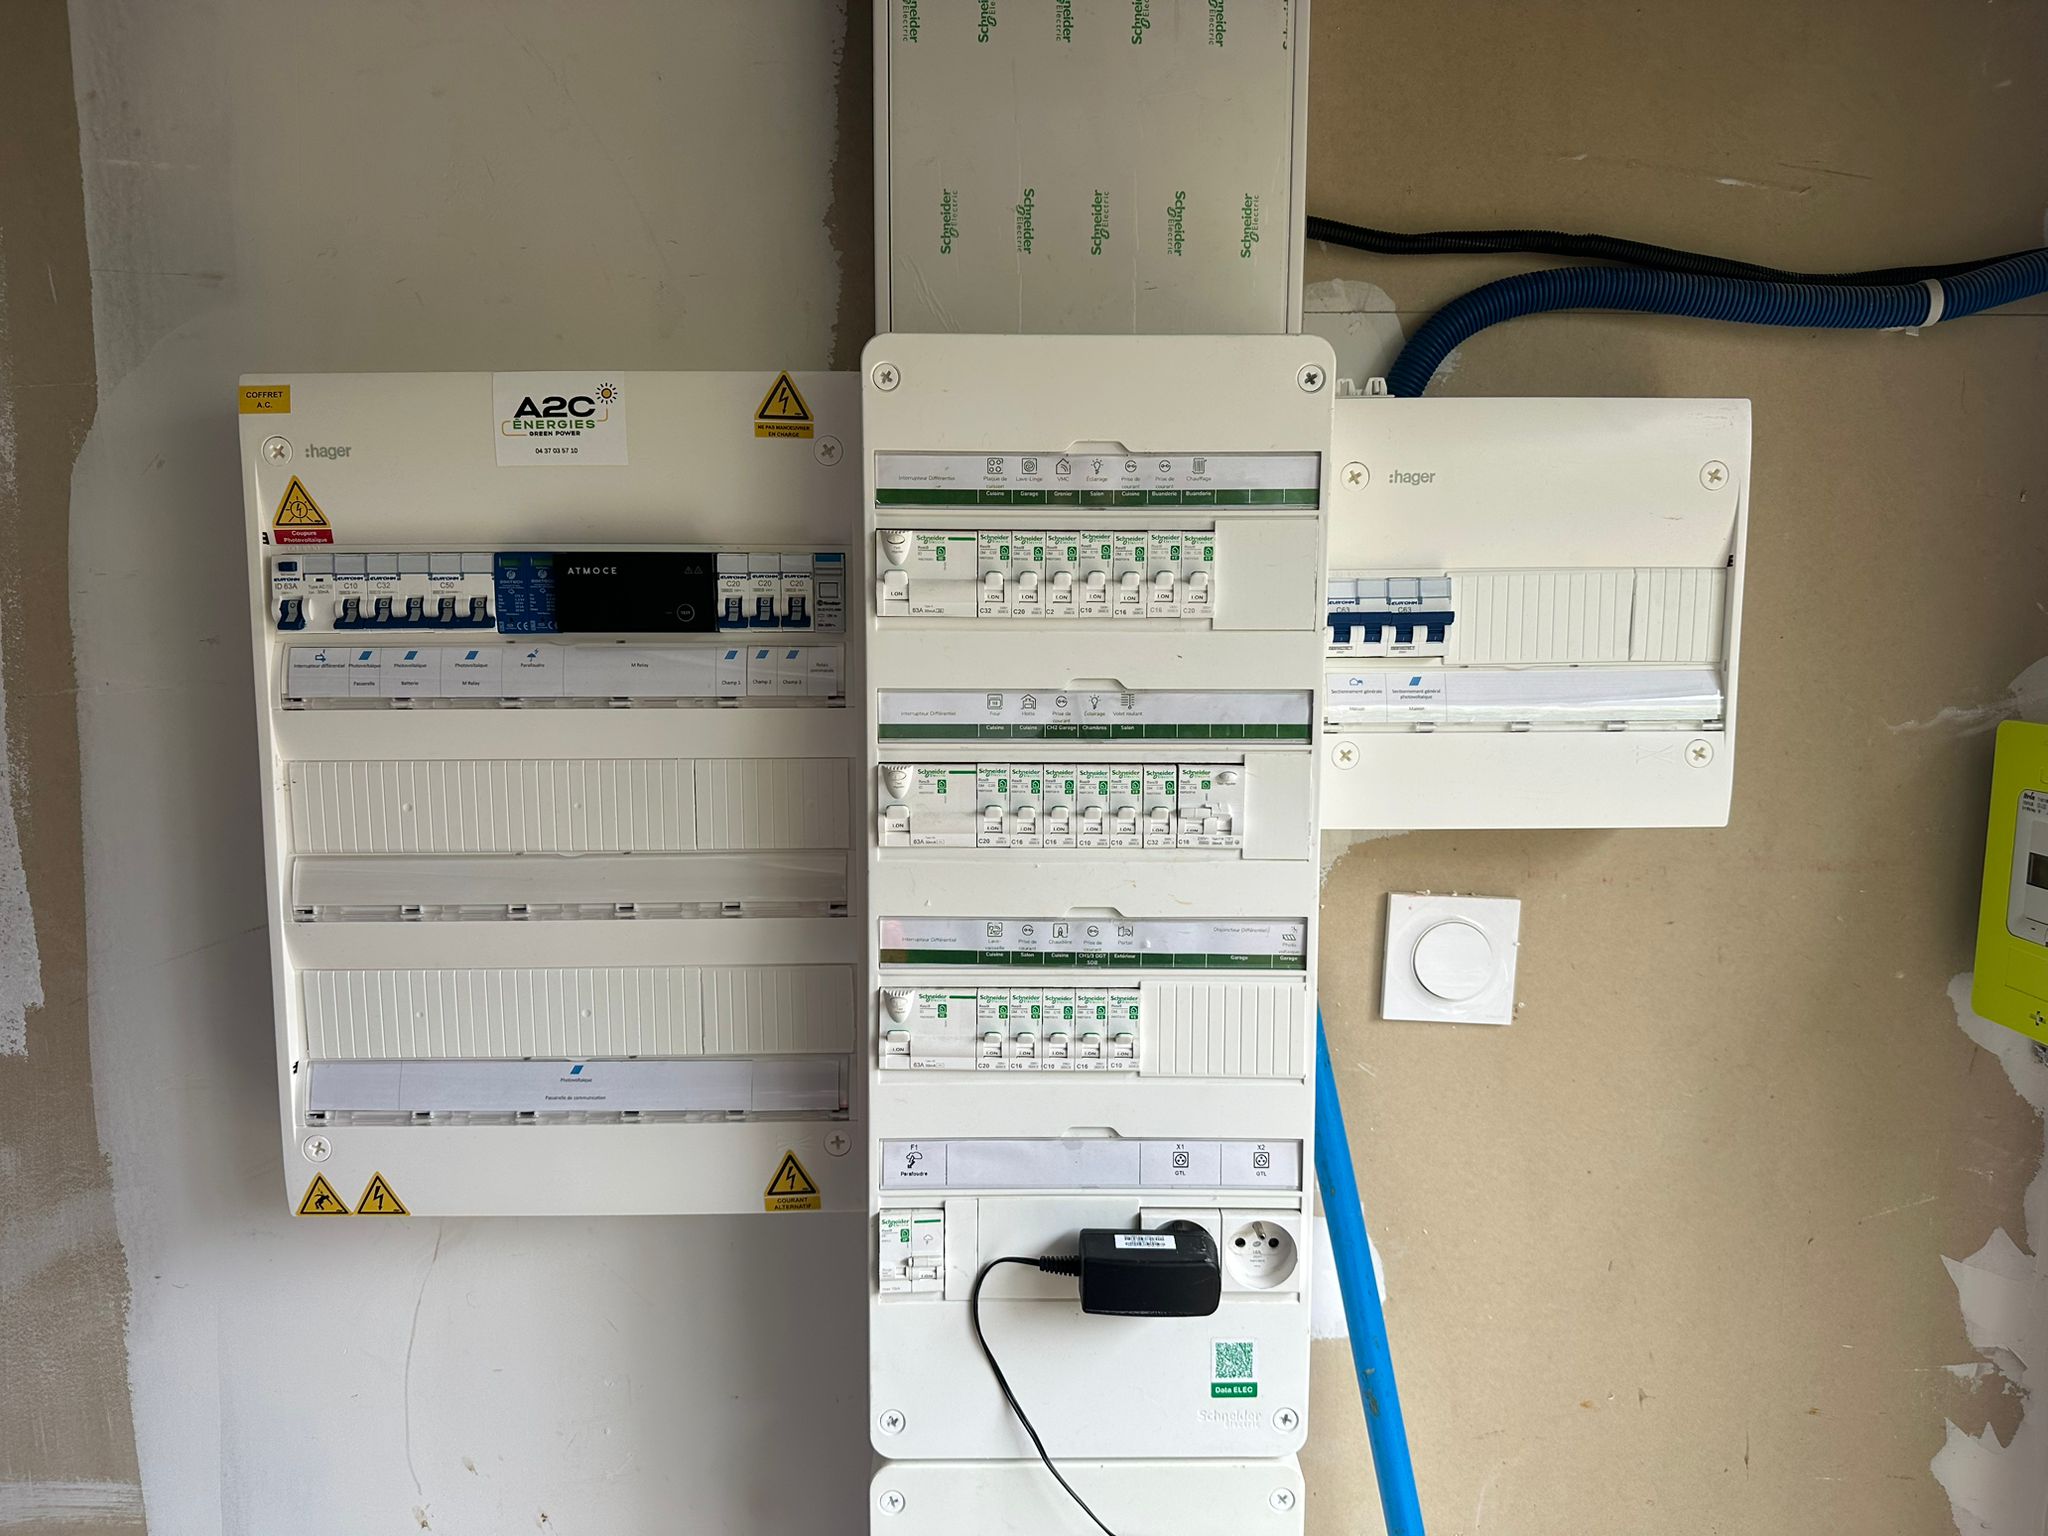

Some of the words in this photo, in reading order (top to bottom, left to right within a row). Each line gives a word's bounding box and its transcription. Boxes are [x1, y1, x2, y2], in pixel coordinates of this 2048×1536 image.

[909, 0, 921, 43] neider
[1062, 0, 1074, 43] neider
[1215, 0, 1227, 47] neider
[1102, 191, 1110, 227] Electric
[940, 188, 952, 255] Schneider
[1023, 188, 1035, 255] Schneider
[1090, 189, 1102, 256] Schneider
[1174, 190, 1186, 256] Schneider
[1240, 192, 1253, 258] Schneider
[245, 391, 284, 399] COFFRET
[256, 401, 273, 409] A.C.
[513, 395, 596, 418] A2C
[916, 535, 946, 544] Schneider
[980, 534, 1009, 543] Schneider
[1014, 535, 1043, 545] Schneider
[1048, 535, 1077, 545] Schneider
[1082, 534, 1111, 543] Schneider
[1116, 536, 1145, 545] Schneider
[1151, 534, 1180, 544] Schneider
[1184, 535, 1214, 545] Schneider
[567, 567, 618, 575] ATMOCE
[917, 769, 946, 778] Schneider
[978, 768, 1007, 777] Schneider
[1045, 770, 1074, 778] Schneider
[1111, 770, 1140, 779] Schneider
[1182, 769, 1211, 778] Schneider
[919, 994, 947, 1002] Schneider
[980, 995, 1008, 1003] Schneider
[1045, 996, 1073, 1004] Schneider
[1110, 996, 1138, 1004] Schneider
[1215, 1386, 1232, 1394] Data
